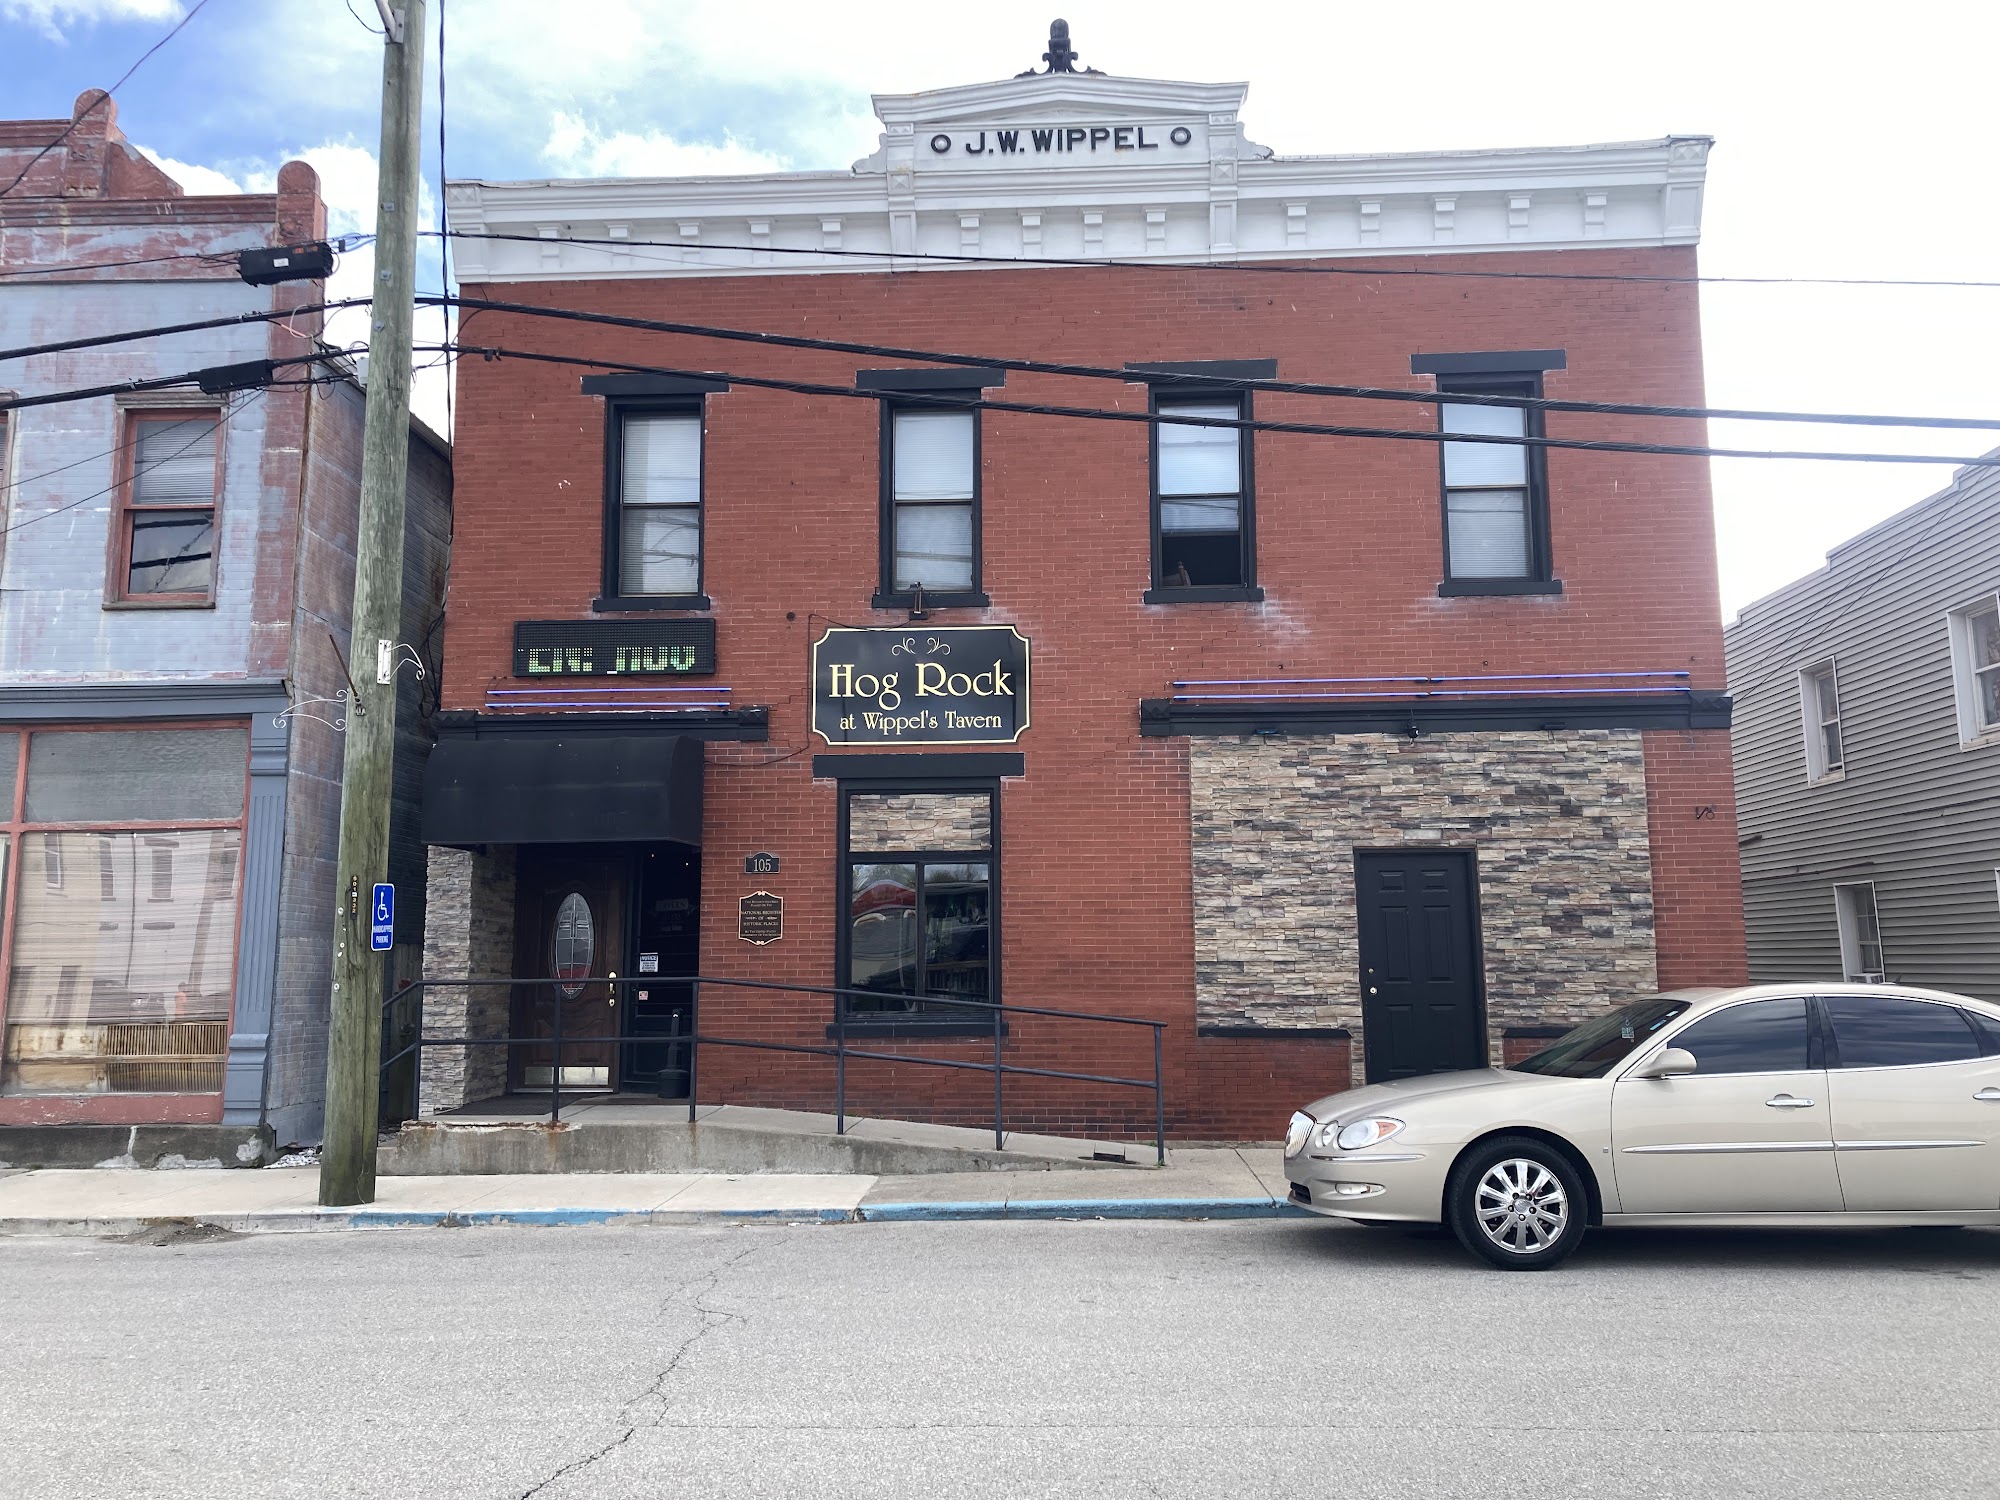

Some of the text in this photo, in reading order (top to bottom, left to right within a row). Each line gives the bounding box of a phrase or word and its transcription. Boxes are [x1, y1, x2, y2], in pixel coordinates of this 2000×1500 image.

[1031, 128, 1159, 152] WIPPEL
[829, 658, 1015, 710] Hog Rock
[840, 710, 1003, 735] at Wippel's Tavern
[753, 858, 772, 872] 105
